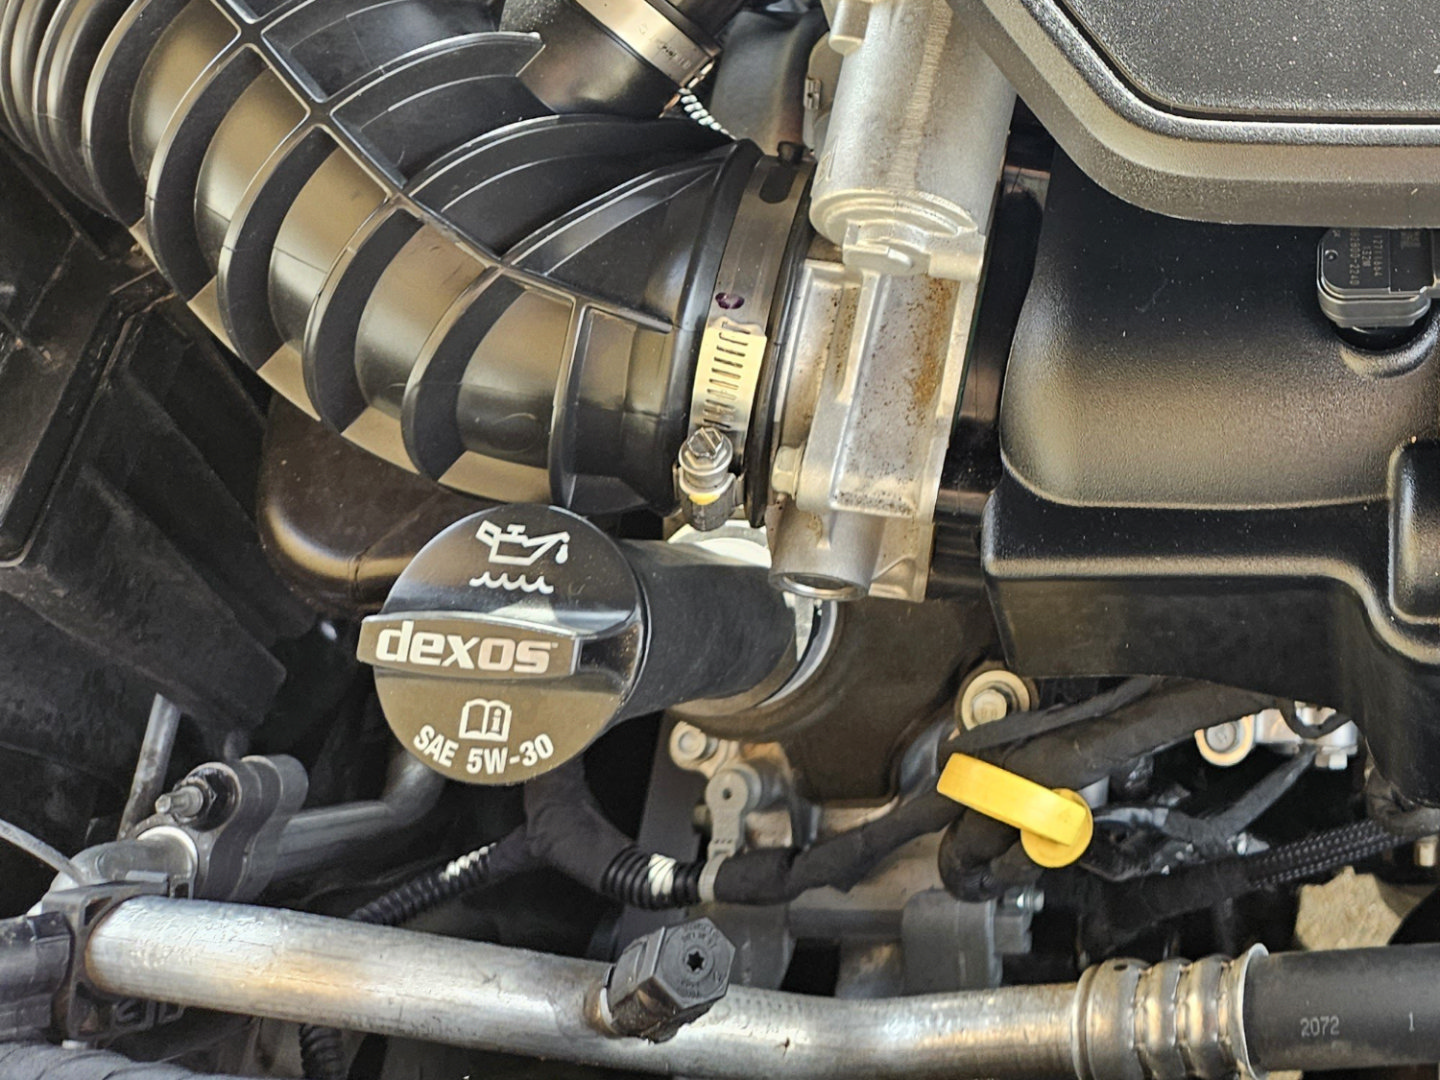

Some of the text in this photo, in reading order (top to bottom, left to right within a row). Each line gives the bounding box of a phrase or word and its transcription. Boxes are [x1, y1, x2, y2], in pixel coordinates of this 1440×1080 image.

[375, 620, 552, 674] dexos
[413, 724, 555, 775] SAE 5W-30
[1300, 1015, 1340, 1037] 2072
